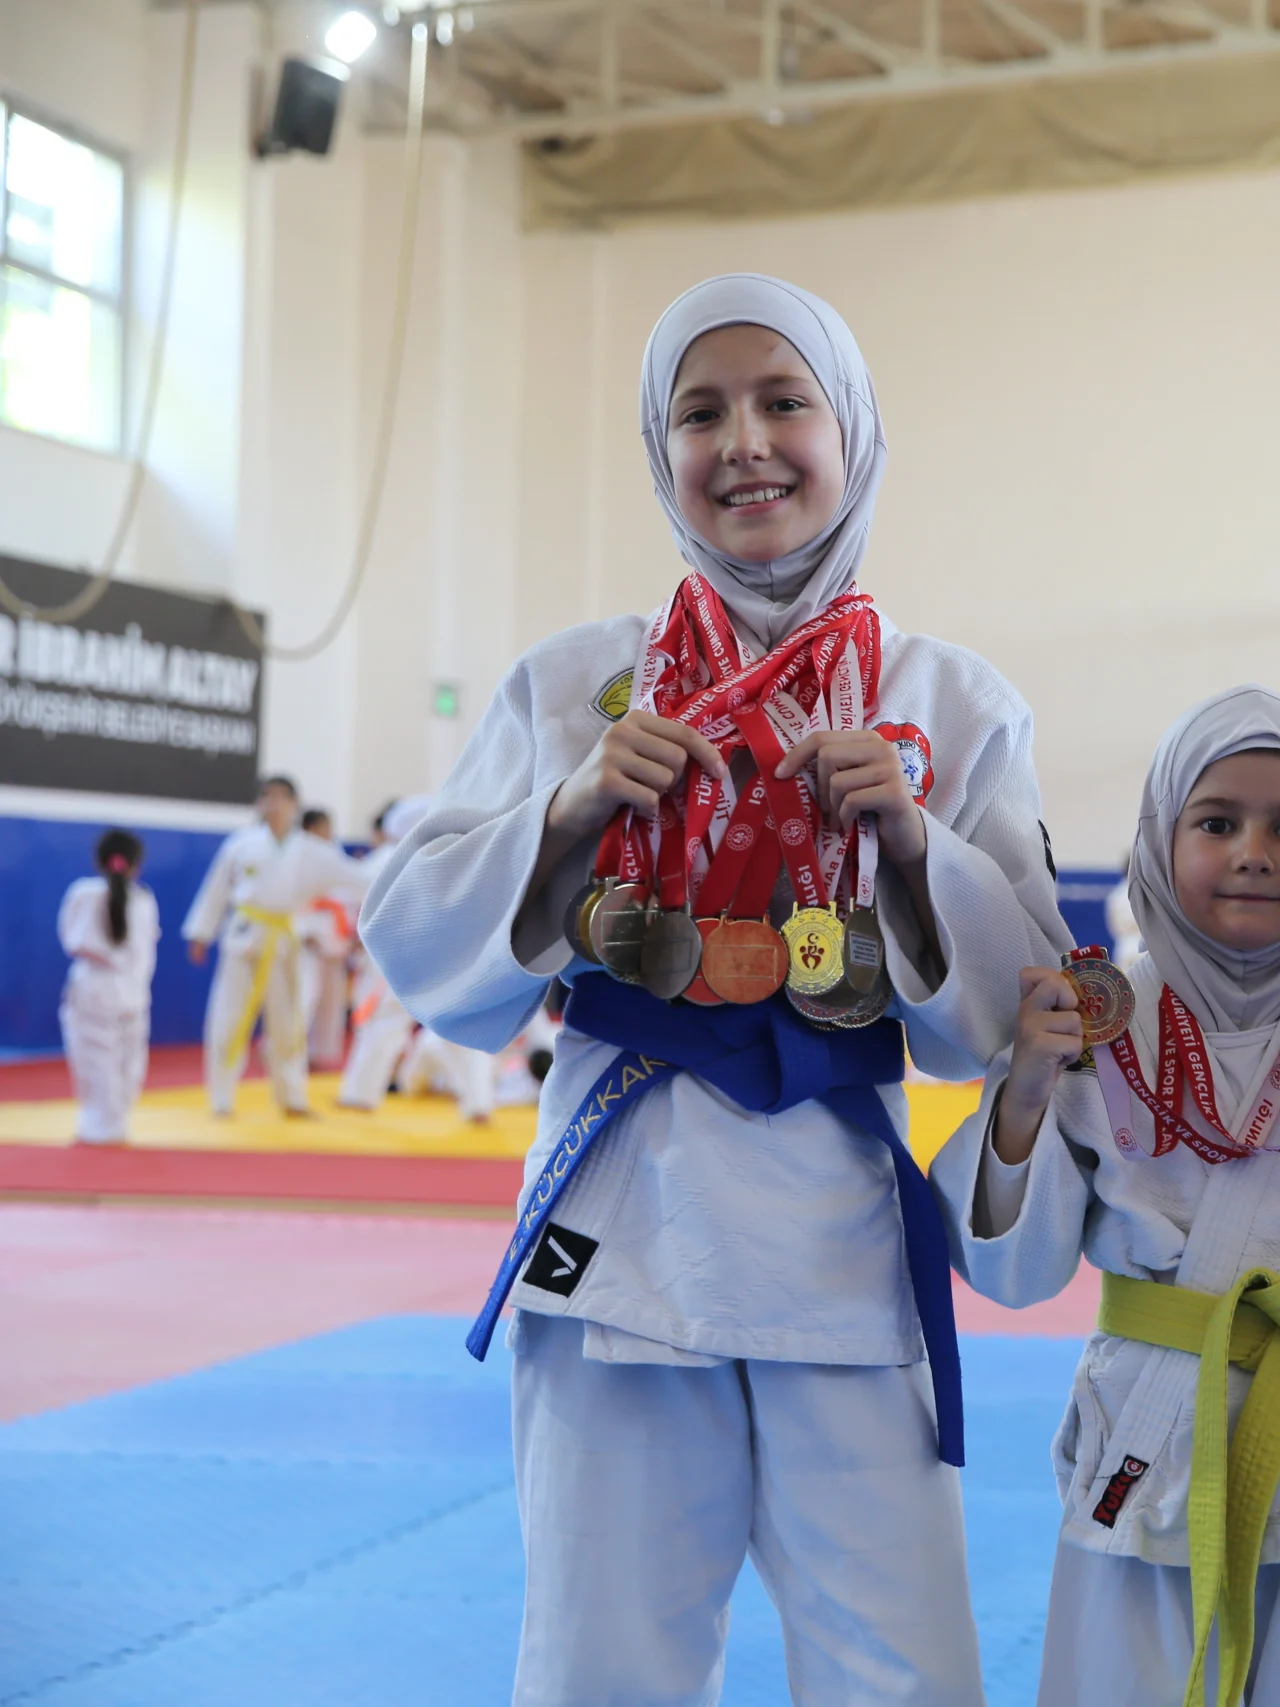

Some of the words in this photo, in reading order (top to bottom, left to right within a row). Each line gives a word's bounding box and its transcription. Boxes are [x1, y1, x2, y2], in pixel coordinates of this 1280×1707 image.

[675, 692, 716, 727] ÜRKİYE
[823, 610, 843, 621] VE
[1115, 1038, 1134, 1063] ETİ
[1126, 1067, 1176, 1126] GENÇLİK
[1174, 1124, 1193, 1139] VE
[1191, 1140, 1228, 1163] SPOR
[1162, 1059, 1176, 1096] SPOR
[1187, 1051, 1215, 1117] GENÇLİK
